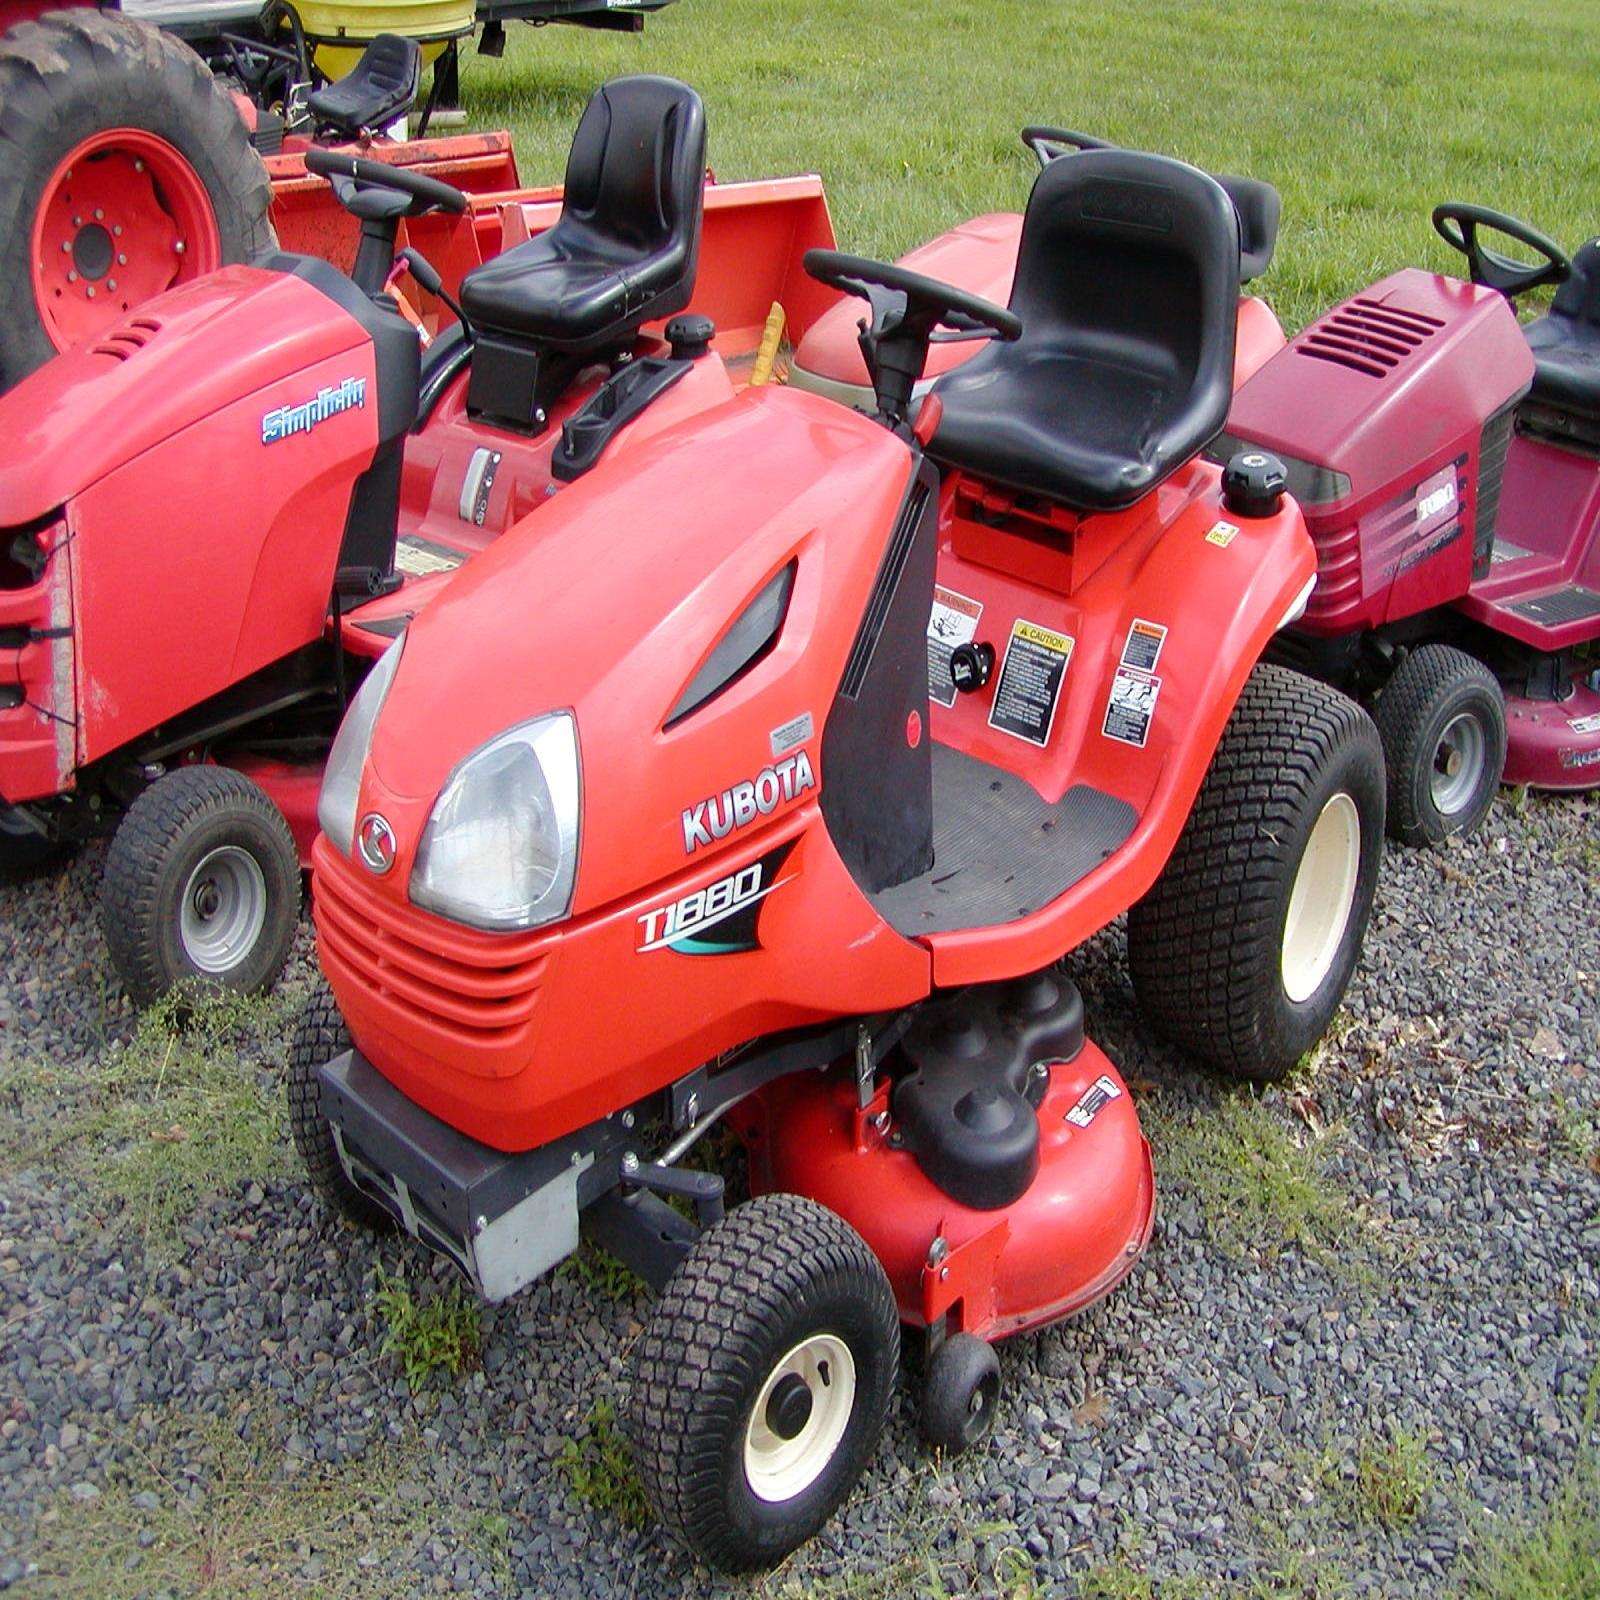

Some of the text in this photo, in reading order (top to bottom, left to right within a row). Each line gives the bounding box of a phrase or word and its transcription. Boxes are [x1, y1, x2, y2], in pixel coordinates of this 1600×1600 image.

[1030, 627, 1065, 649] CAUTION
[681, 749, 817, 855] KUBOTA
[637, 862, 763, 945] T1880
